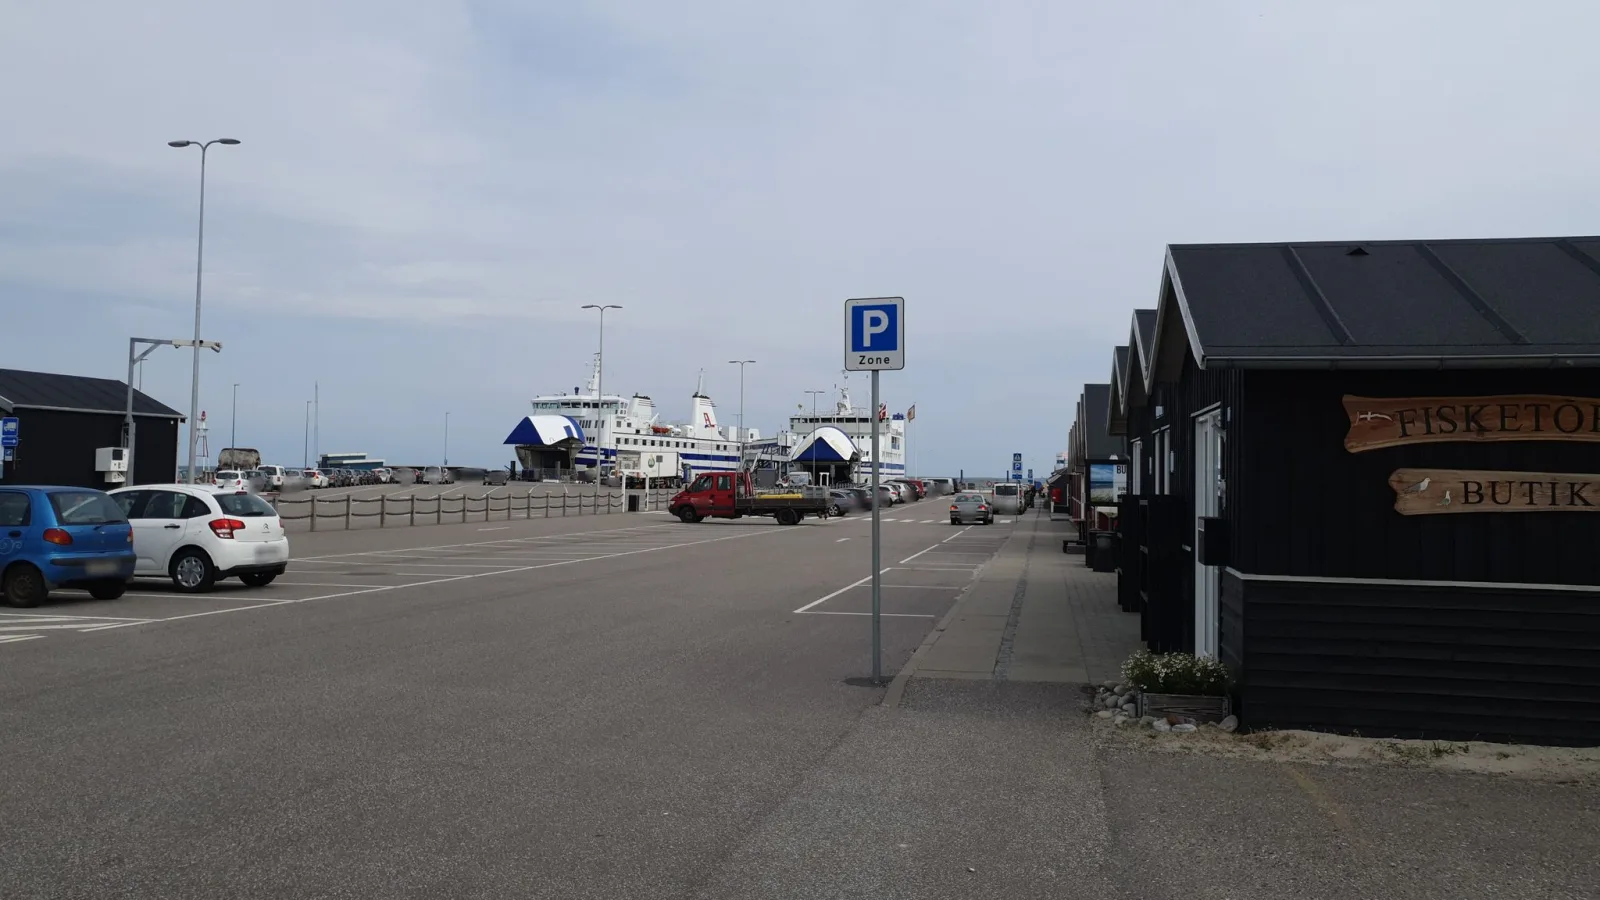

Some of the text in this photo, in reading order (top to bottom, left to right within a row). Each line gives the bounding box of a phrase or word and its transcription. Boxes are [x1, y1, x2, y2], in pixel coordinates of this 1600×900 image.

[863, 309, 889, 347] P
[858, 355, 890, 365] Zone
[1461, 481, 1595, 506] BUTIK
